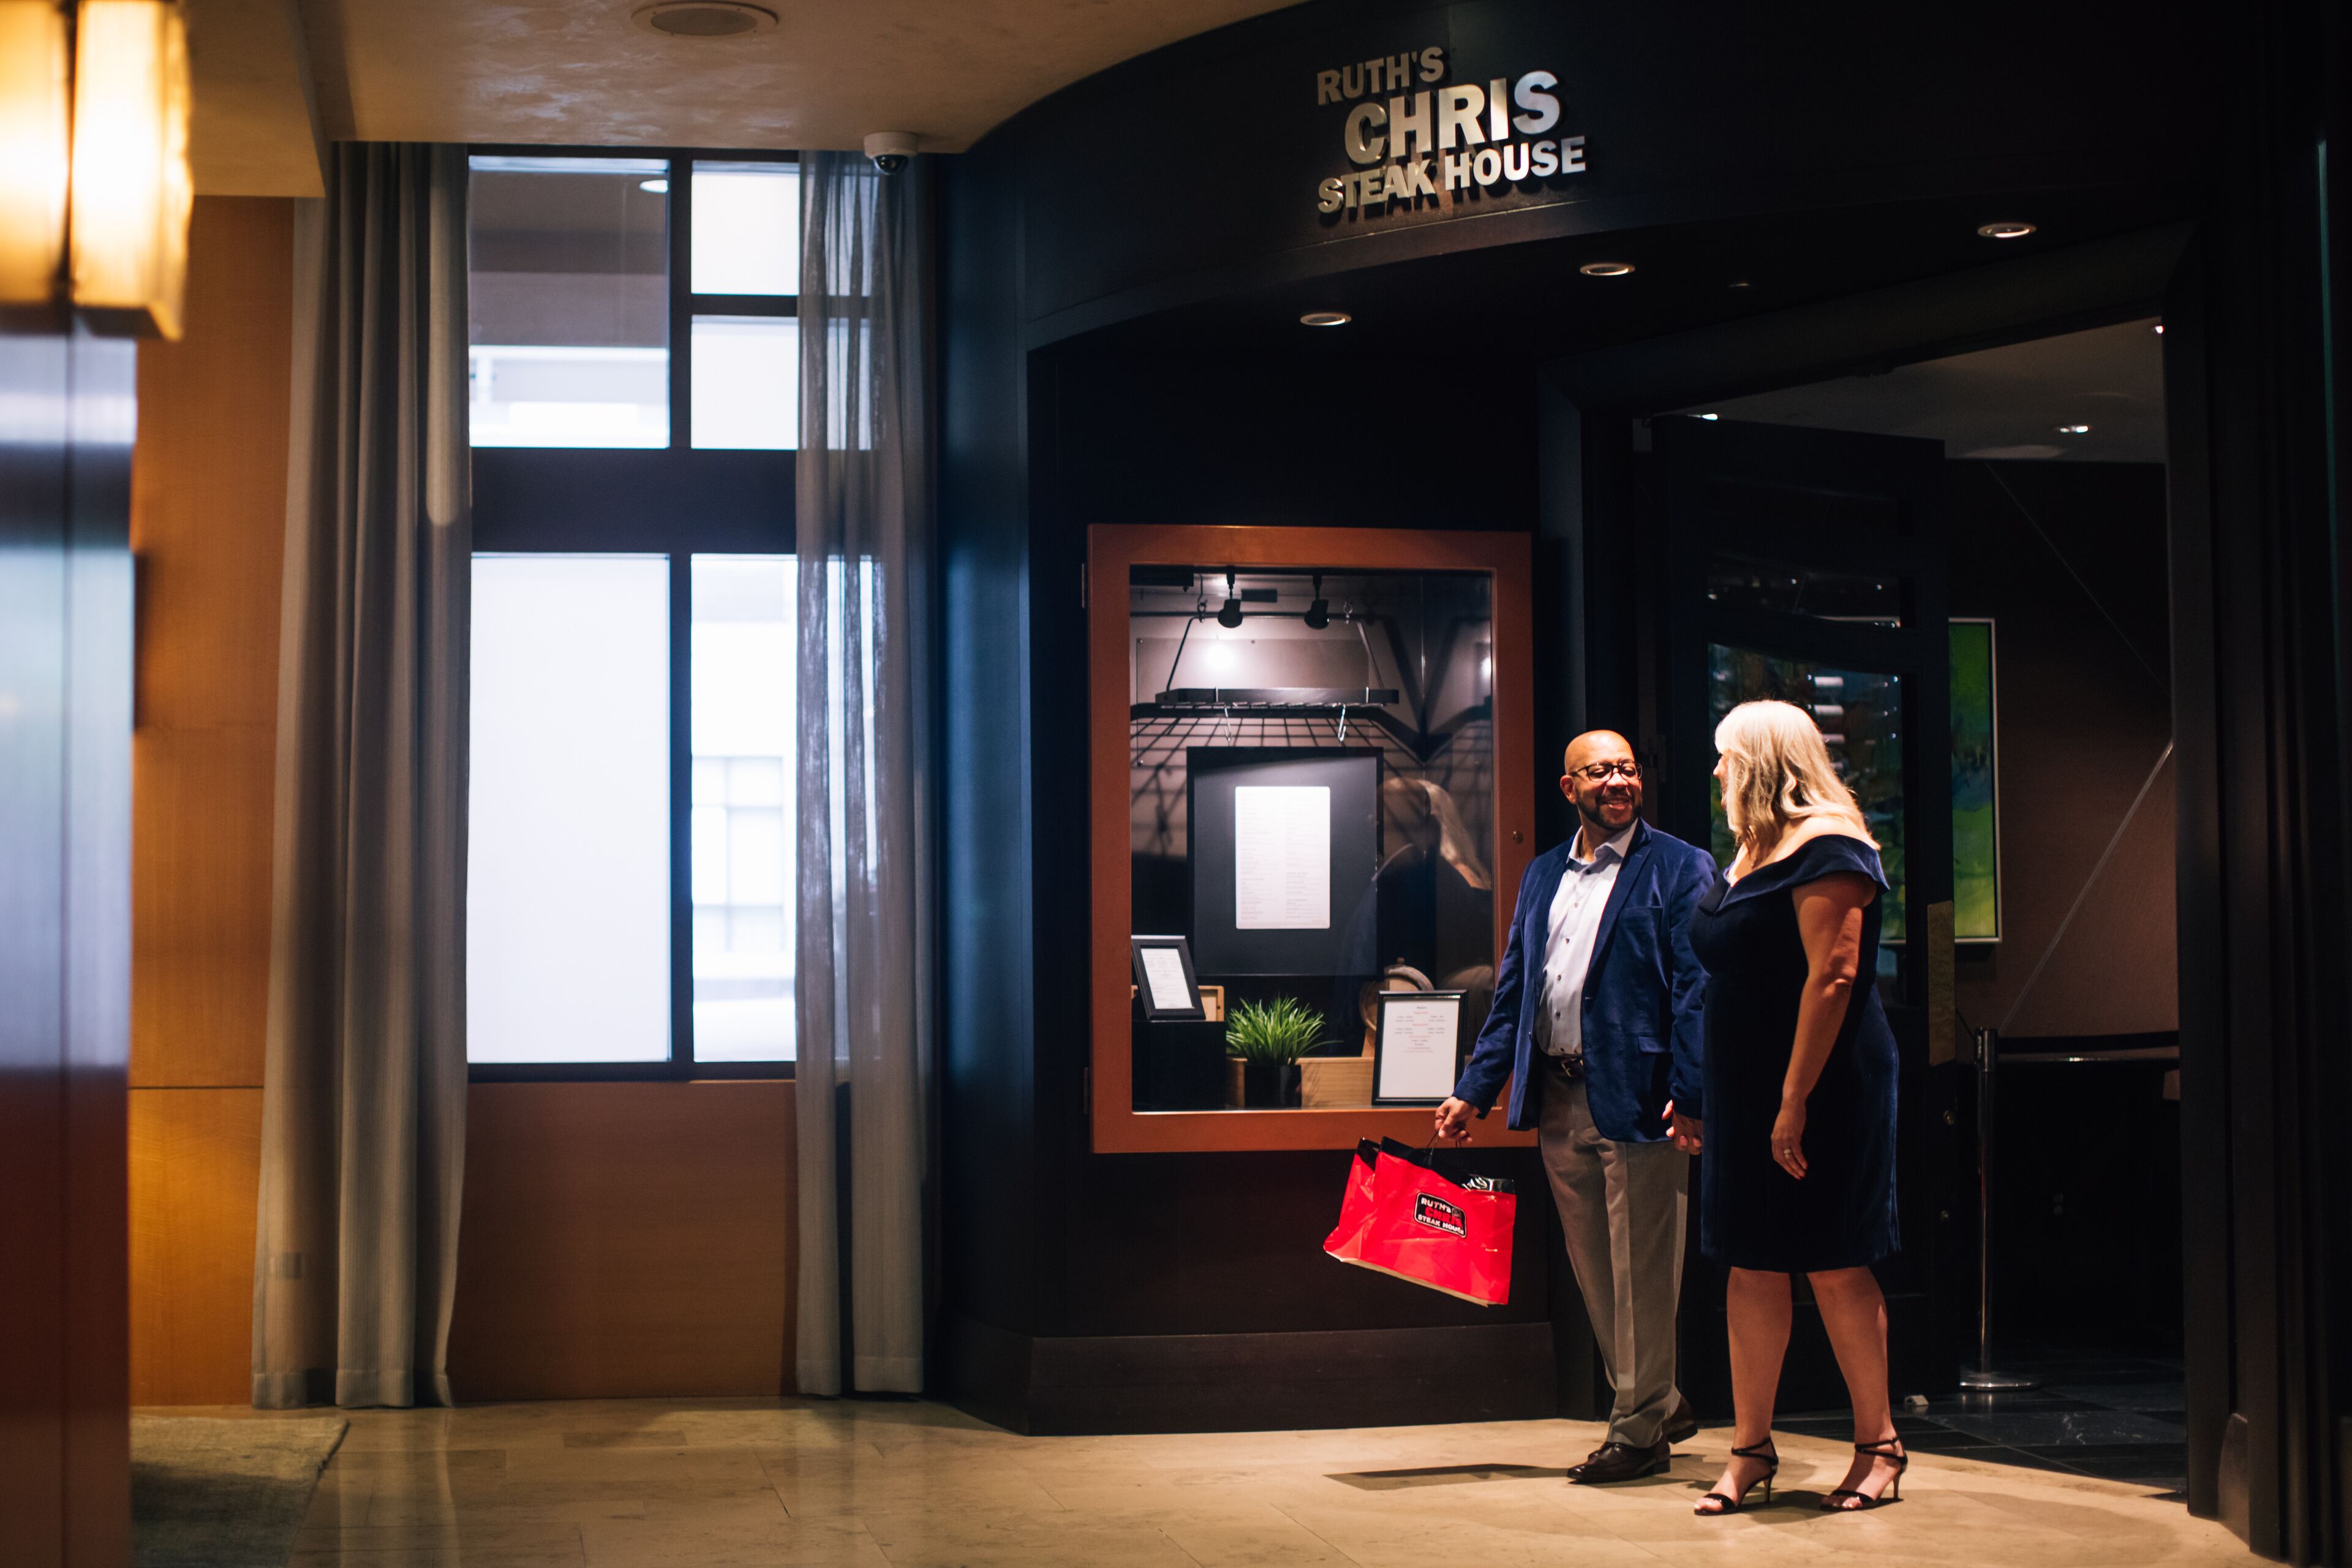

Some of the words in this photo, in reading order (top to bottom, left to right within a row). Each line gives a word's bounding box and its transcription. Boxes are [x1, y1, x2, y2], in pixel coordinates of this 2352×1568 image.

[1317, 47, 1444, 105] RUTH'S
[1344, 70, 1561, 164] CHRIS
[1317, 160, 1436, 213] STEAK
[1445, 136, 1586, 190] HOUSE
[1418, 1214, 1441, 1226] STEAK
